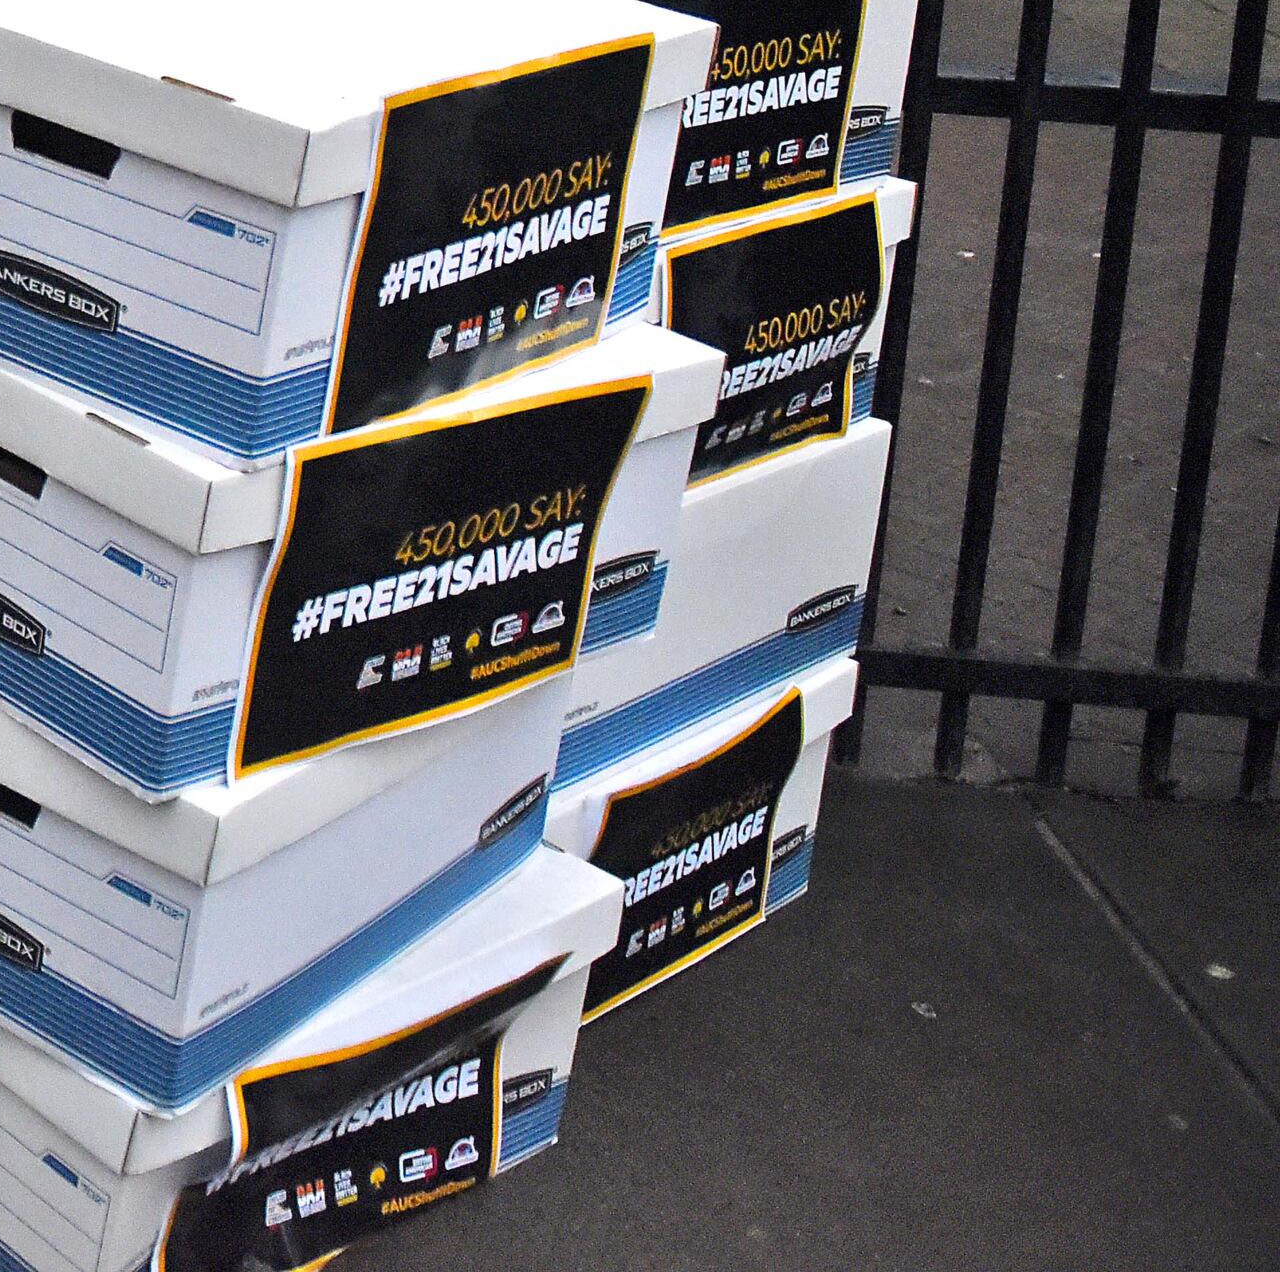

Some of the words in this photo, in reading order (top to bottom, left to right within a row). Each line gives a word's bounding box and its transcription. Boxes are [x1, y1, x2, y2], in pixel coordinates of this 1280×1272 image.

[796, 29, 842, 66] SAY:
[681, 65, 843, 129] REE21SAVAGE
[462, 168, 562, 229] 450,000
[564, 152, 613, 198] SAY:
[379, 194, 612, 308] #FREE21SAVAGE
[68, 293, 110, 322] BOX
[744, 304, 824, 355] 450,000
[852, 361, 866, 374] OX
[395, 502, 521, 565] 450,000
[524, 484, 587, 531] SAY:
[291, 522, 585, 644] #FREE21SAVAGE
[624, 562, 650, 580] BOX
[2, 613, 38, 646] BOX
[790, 601, 833, 627] BANKERS
[832, 593, 851, 608] BOX
[624, 805, 769, 908] REE21SAVAGE
[519, 1079, 546, 1099] BOX
